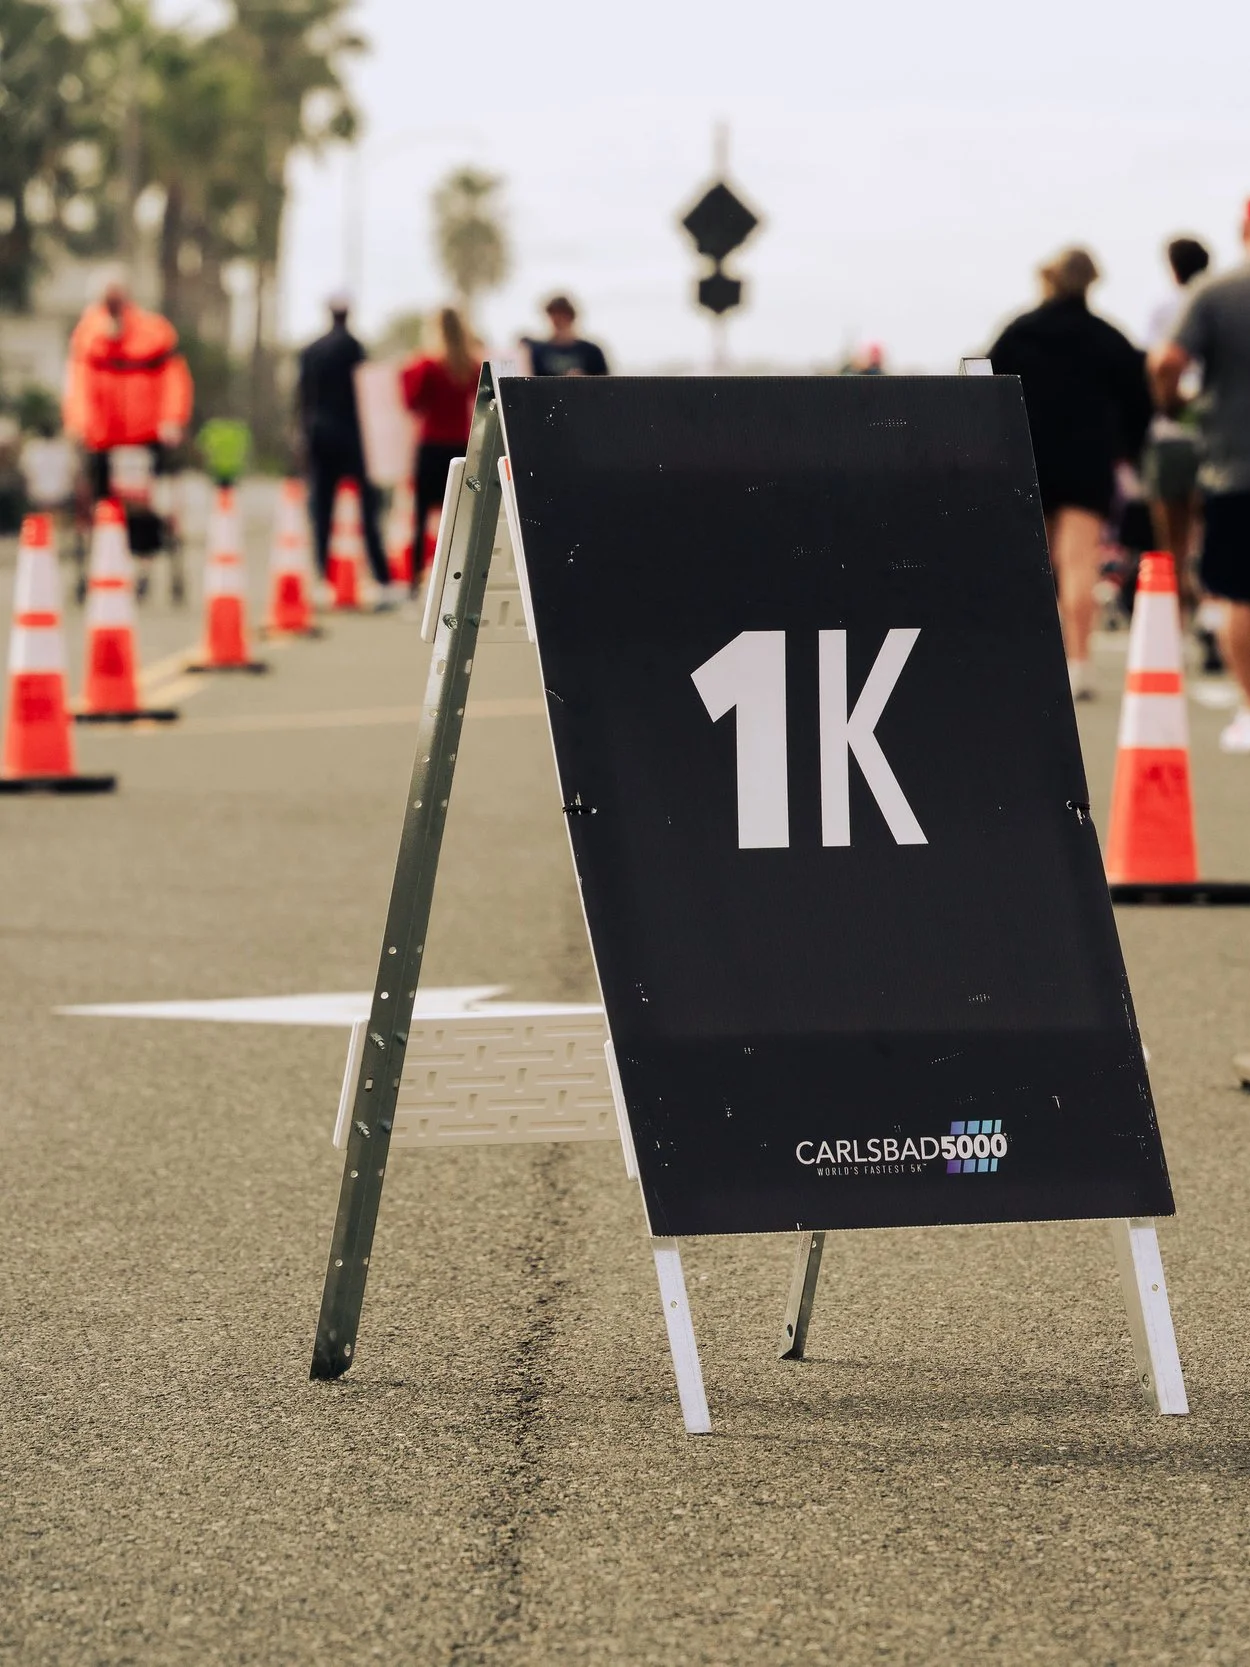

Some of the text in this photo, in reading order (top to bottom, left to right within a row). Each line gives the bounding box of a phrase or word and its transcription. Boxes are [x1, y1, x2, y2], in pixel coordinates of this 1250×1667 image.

[690, 627, 928, 849] 1K
[795, 1133, 1008, 1165] CARLSBAD5000
[816, 1166, 859, 1176] WORLD'S
[864, 1164, 905, 1175] FASTEST
